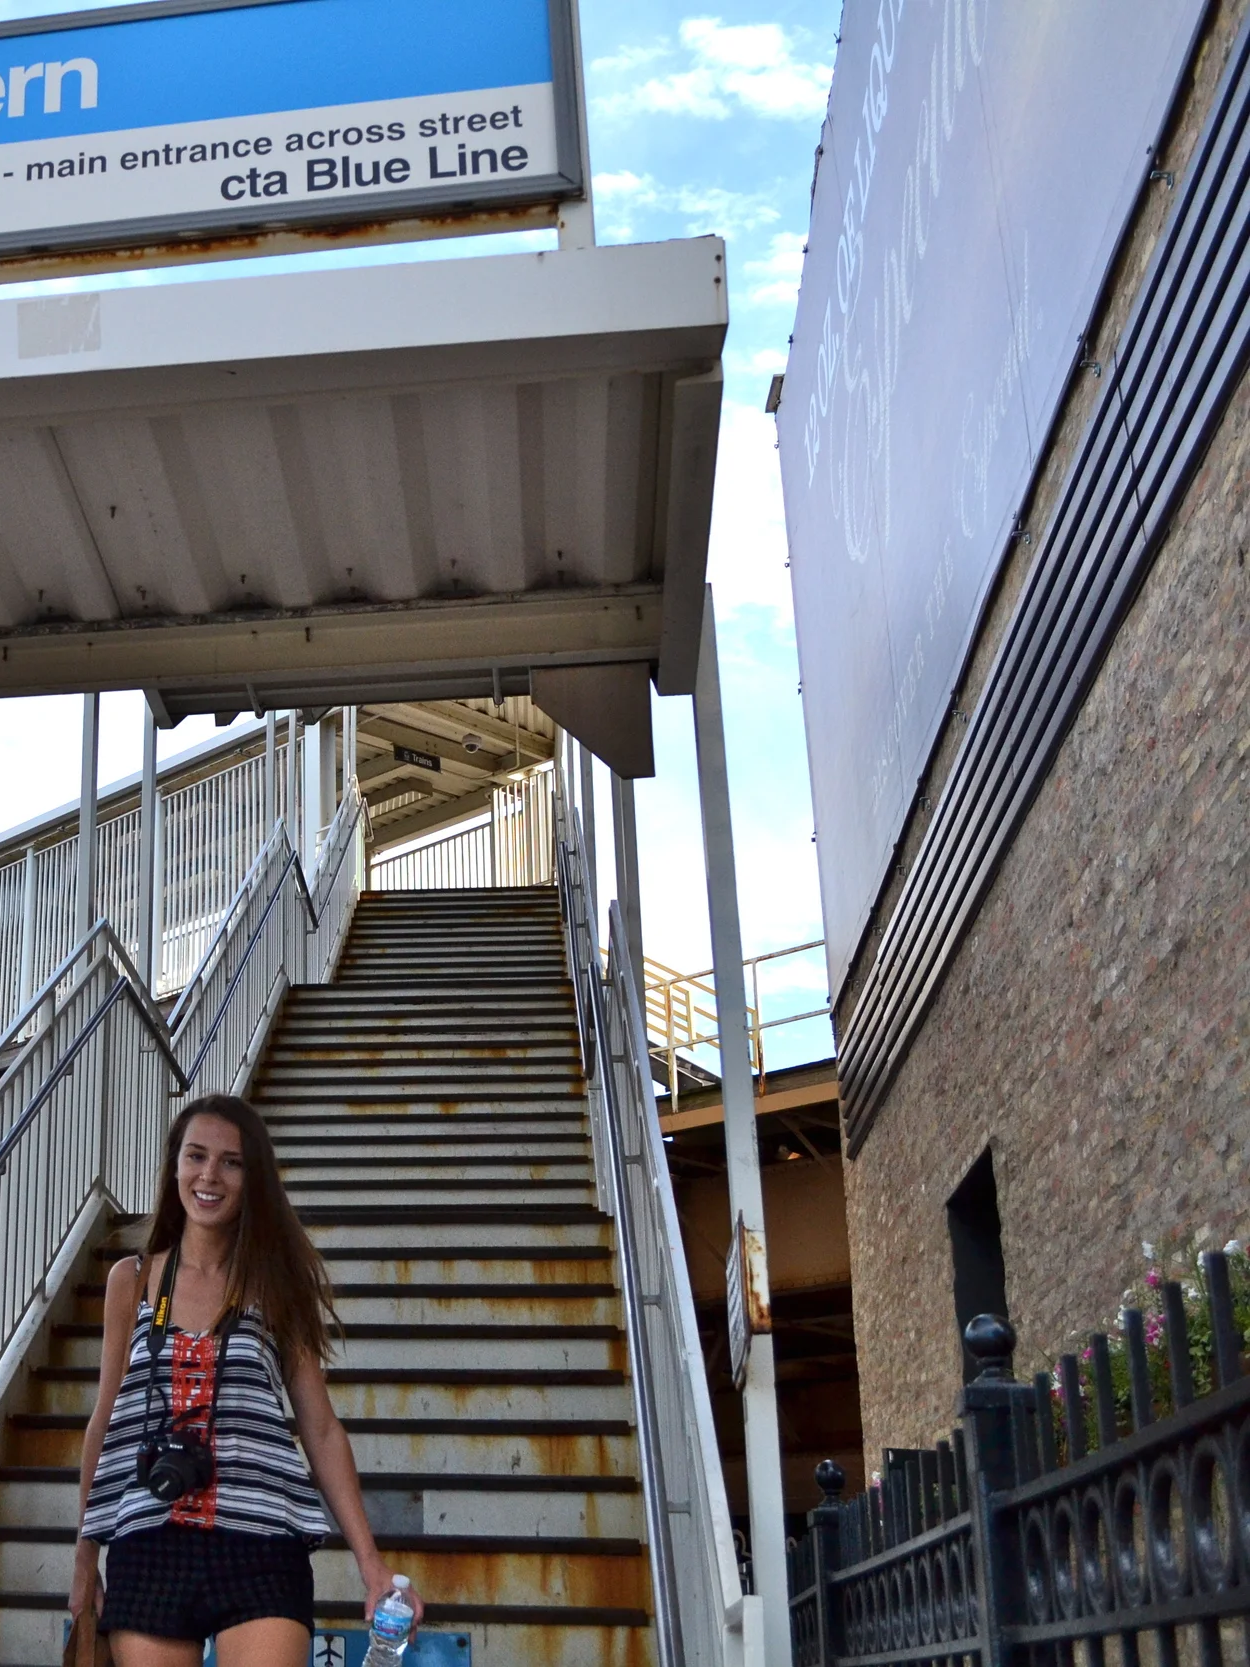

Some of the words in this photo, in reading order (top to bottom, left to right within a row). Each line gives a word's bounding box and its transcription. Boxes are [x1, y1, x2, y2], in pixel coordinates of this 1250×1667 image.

[3, 170, 15, 179] -
[25, 151, 108, 182] main
[119, 135, 273, 172] entrance
[284, 121, 406, 153] across
[418, 104, 524, 138] street
[220, 167, 289, 201] cta
[306, 155, 411, 193] Blue
[428, 143, 529, 180] Line
[412, 753, 433, 767] Trains
[155, 1296, 168, 1326] Nikon
